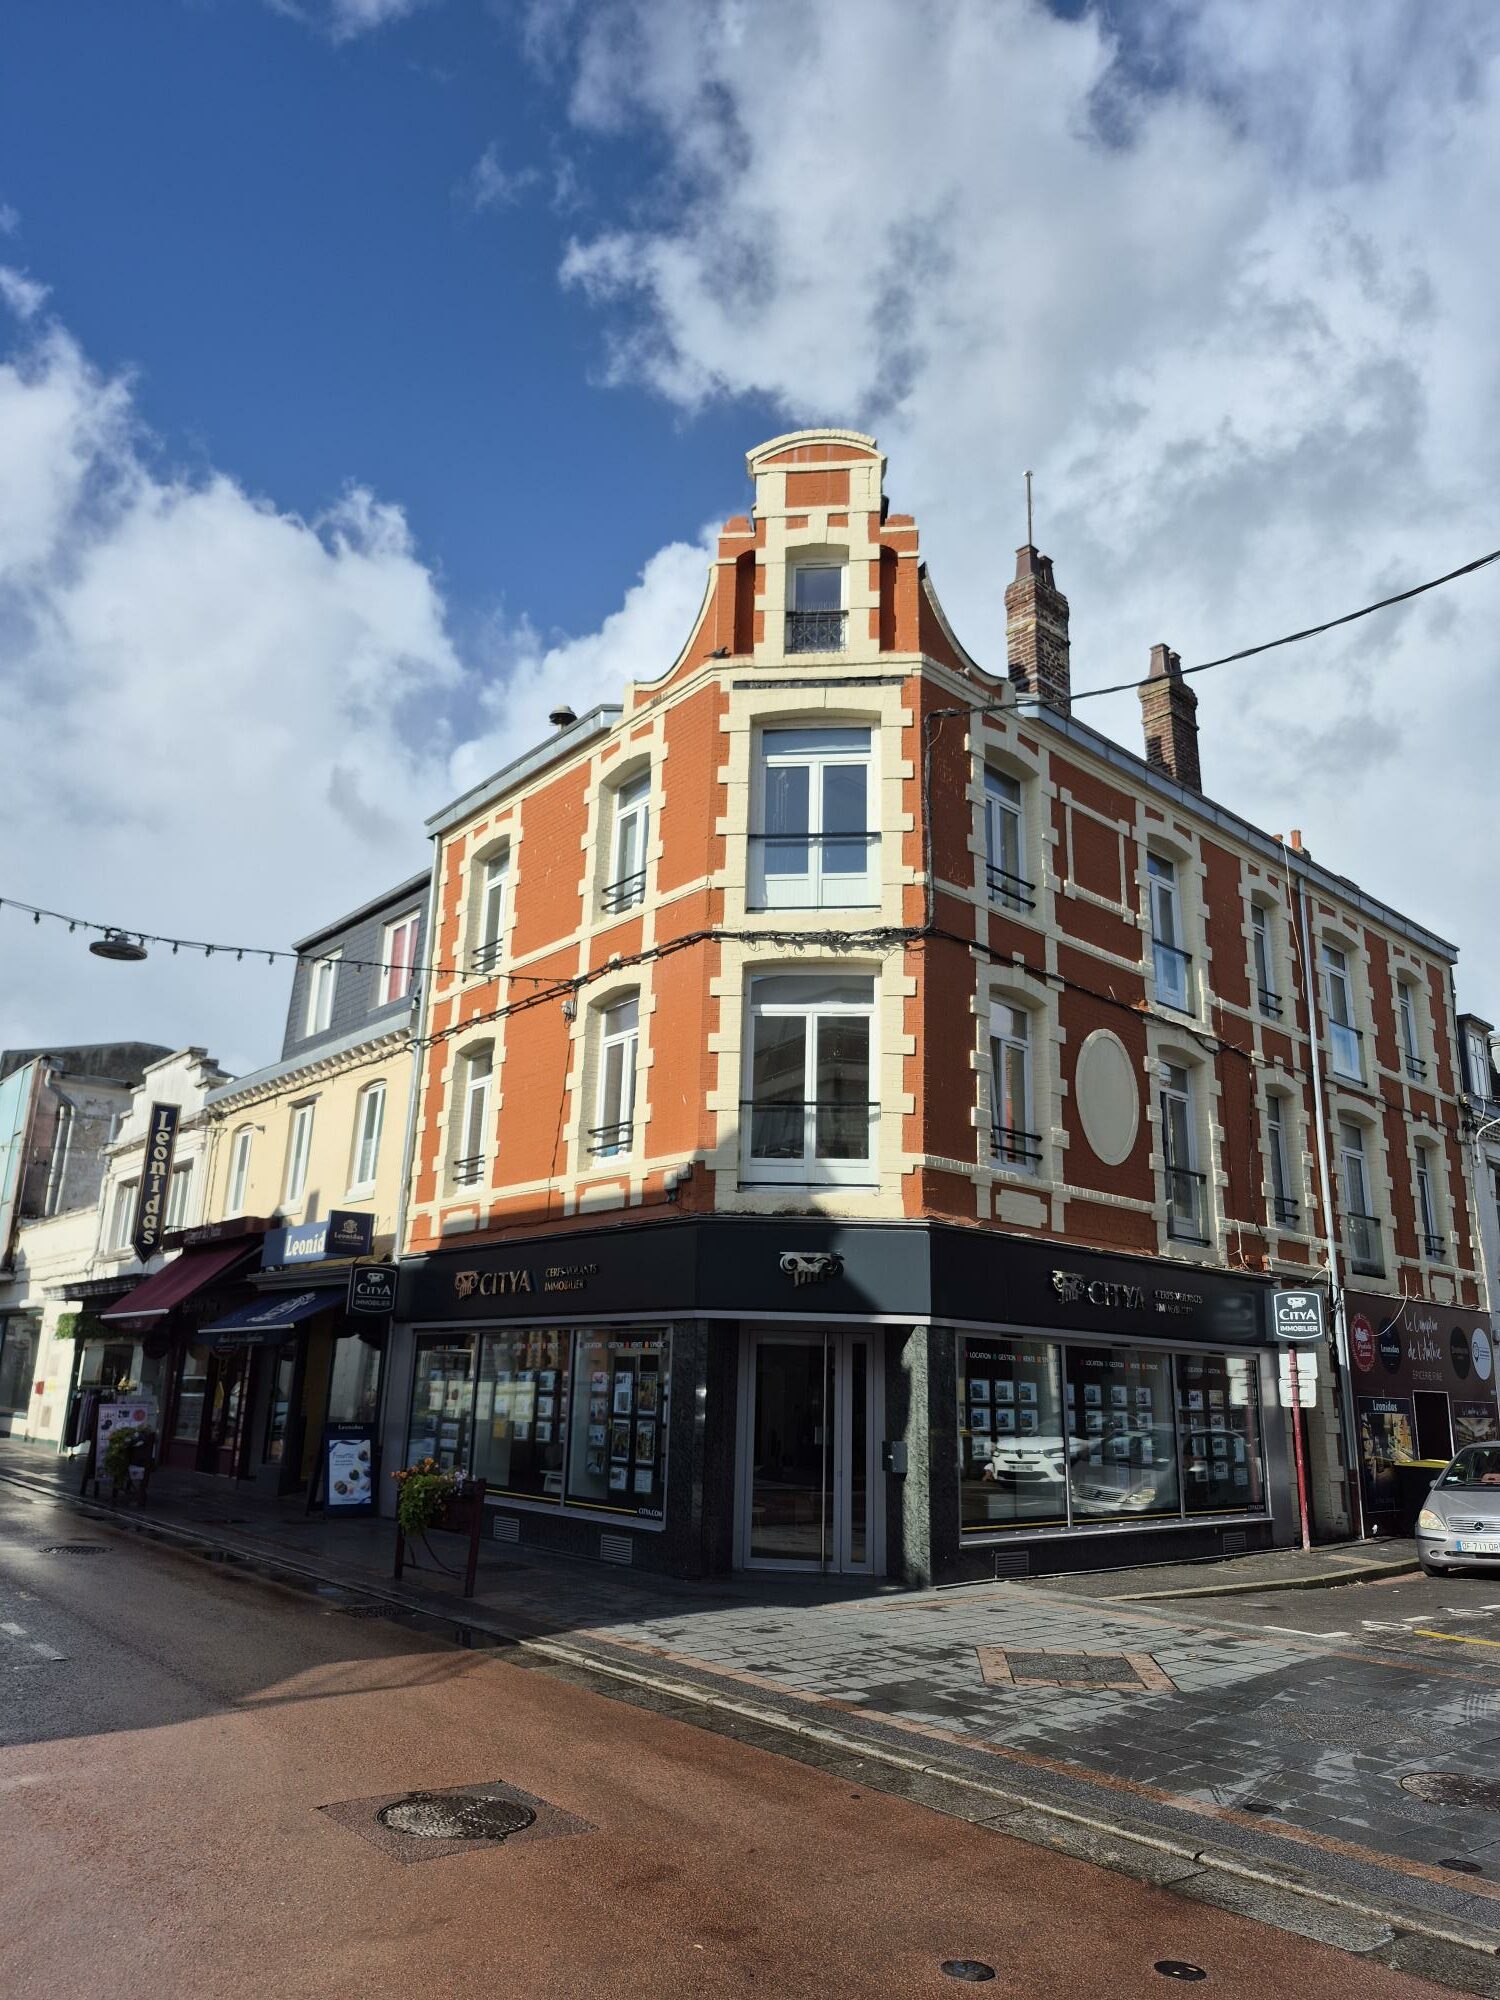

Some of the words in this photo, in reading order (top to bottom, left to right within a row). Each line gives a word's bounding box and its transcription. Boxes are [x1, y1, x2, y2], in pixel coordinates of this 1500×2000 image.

[143, 1111, 171, 1245] Leonidas
[285, 1229, 327, 1257] Leonid
[334, 1231, 364, 1241] Leonidas
[479, 1270, 531, 1296] CITYA
[1088, 1281, 1145, 1310] CITYA
[969, 1351, 992, 1360] LOCATION
[998, 1353, 1016, 1361] GESTION
[1380, 1344, 1400, 1354] Leonidas
[1372, 1399, 1398, 1412] Leonidas
